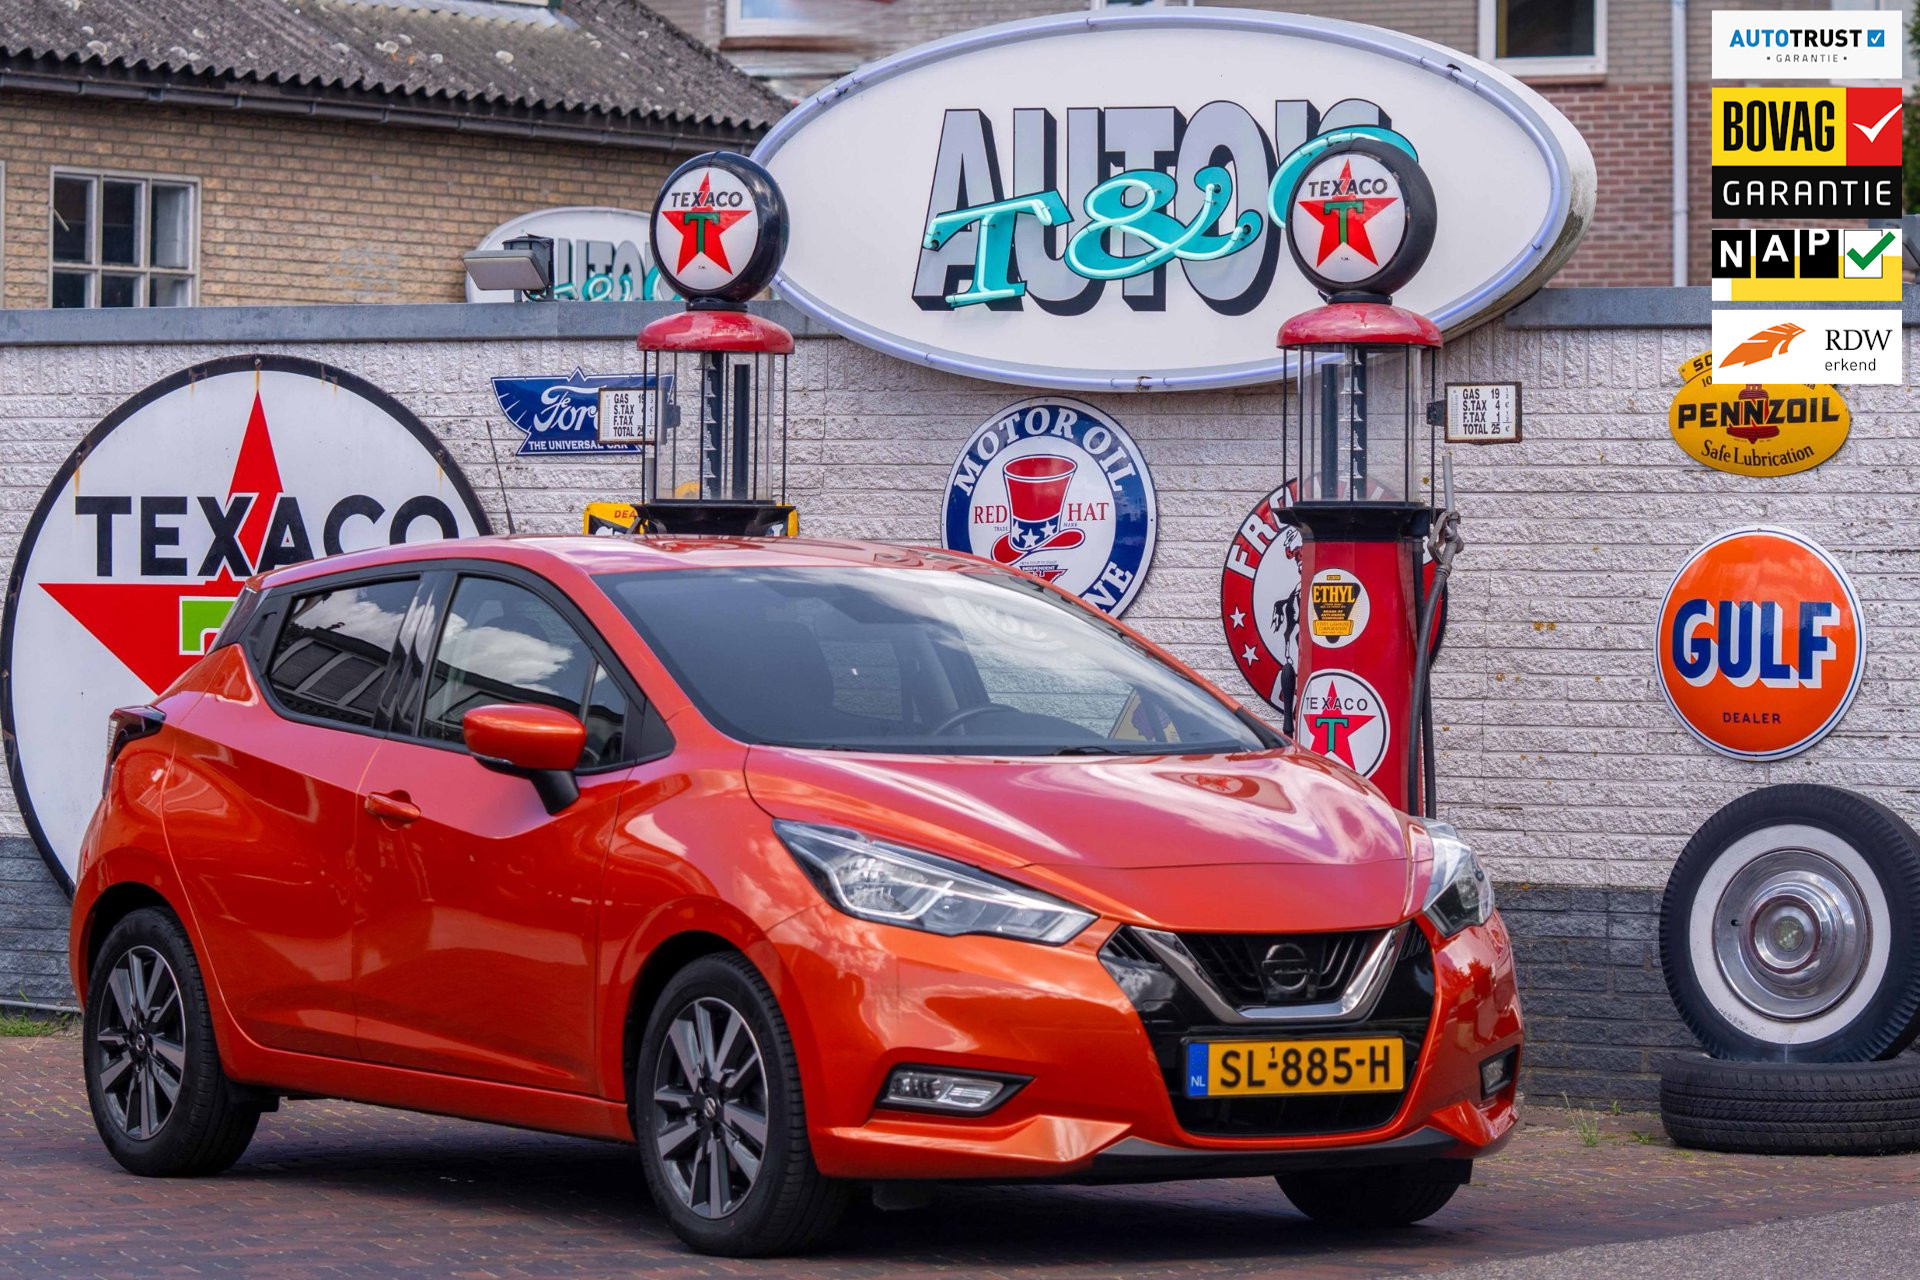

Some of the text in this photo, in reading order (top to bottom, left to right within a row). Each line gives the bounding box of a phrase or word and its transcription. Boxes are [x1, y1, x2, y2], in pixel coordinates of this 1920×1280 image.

[1308, 178, 1388, 197] TEXACO
[671, 191, 743, 208] TEXACO
[912, 99, 1392, 317] AUTO'
[614, 393, 629, 404] GAS
[1463, 388, 1480, 400] GAS
[1491, 388, 1500, 400] 19
[533, 385, 607, 432] For
[613, 405, 634, 415] S.TAX
[1463, 400, 1487, 411] S.TAX
[1495, 400, 1500, 411] 4
[1463, 412, 1486, 422] F.TAX
[1496, 411, 1500, 422] 1
[1678, 397, 1839, 429] PENNZOIL
[613, 416, 633, 426] F.TAX
[613, 427, 635, 437] TOTAL
[1463, 424, 1488, 435] TOTAL
[1491, 424, 1500, 434] 25
[528, 441, 548, 450] THE
[549, 439, 603, 450] UNIVERSAL
[953, 408, 1136, 497] MOTOR OIL
[1701, 440, 1814, 466] Safe Lubrication
[974, 502, 1109, 524] RED HAT
[1313, 585, 1355, 603] ETHYL
[1672, 599, 1840, 688] GULF
[1306, 697, 1368, 711] TEXACO
[1723, 712, 1781, 724] DEALER
[1220, 1046, 1390, 1088] SL-885-H
[1191, 1076, 1206, 1087] NL
